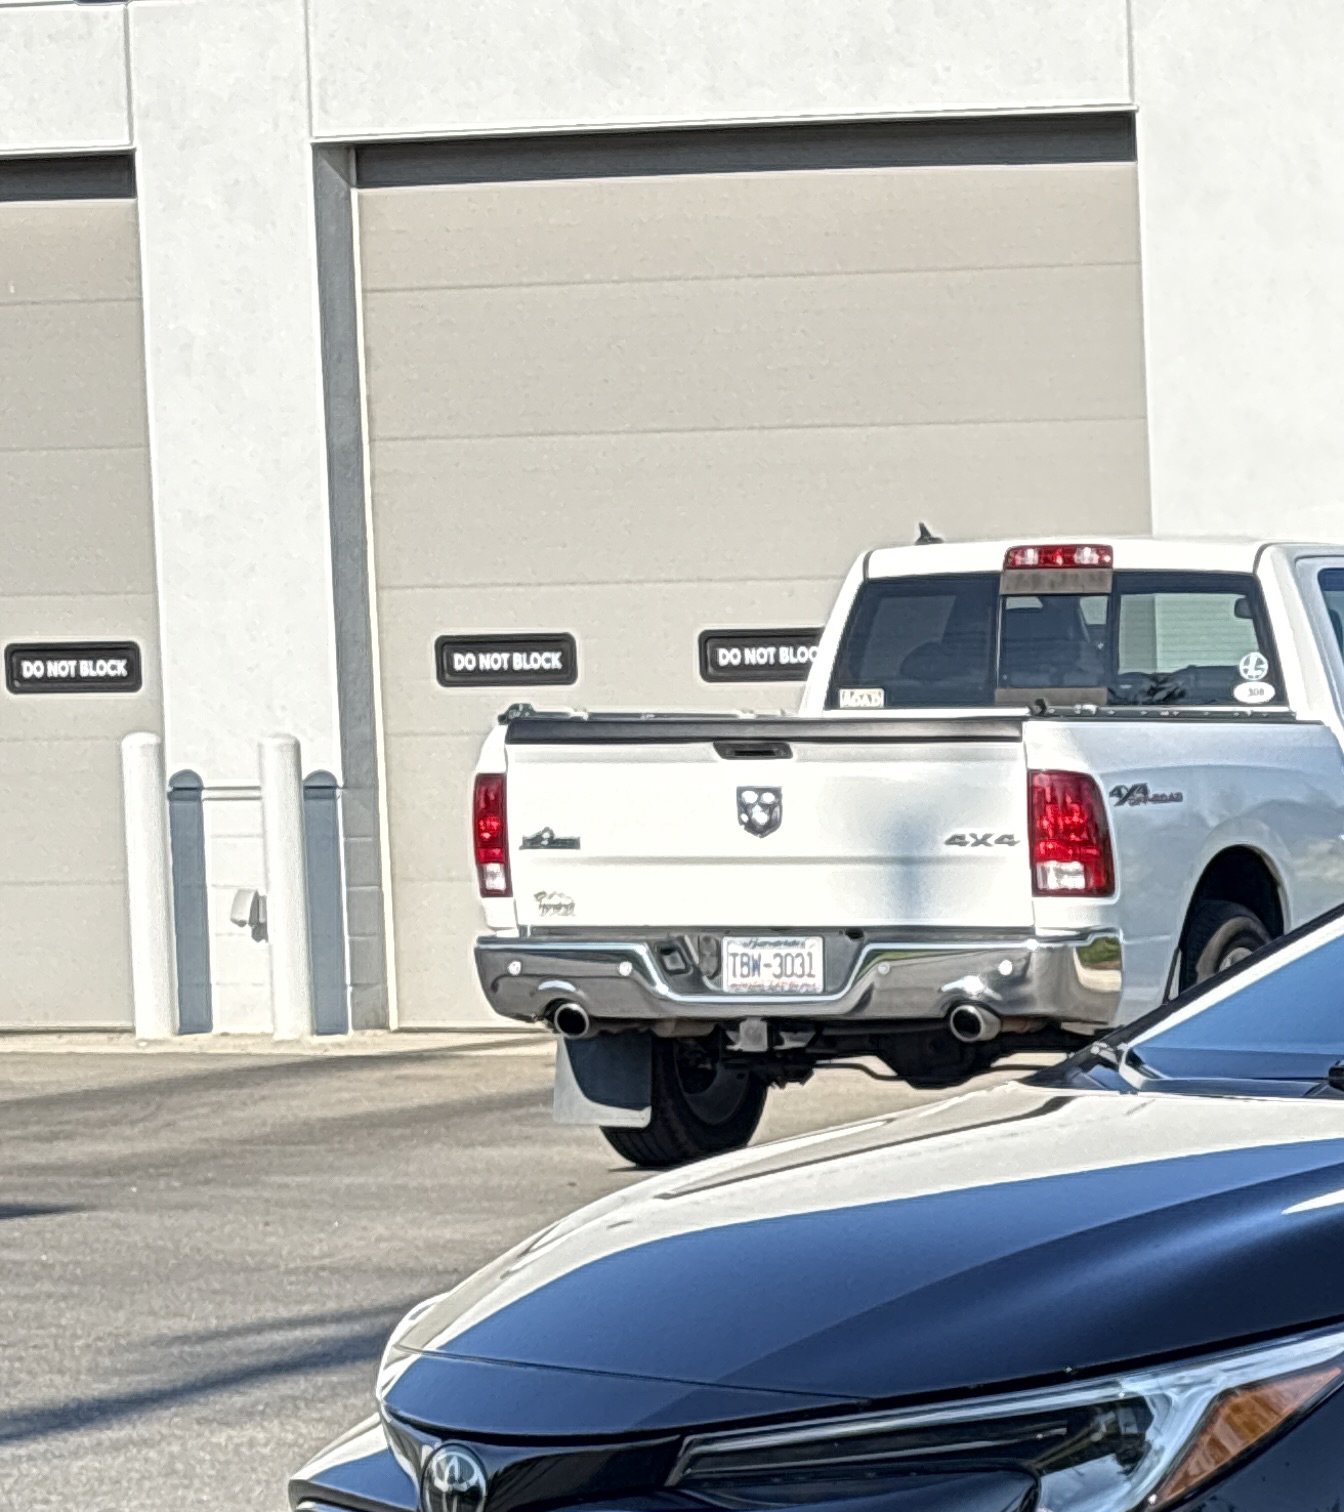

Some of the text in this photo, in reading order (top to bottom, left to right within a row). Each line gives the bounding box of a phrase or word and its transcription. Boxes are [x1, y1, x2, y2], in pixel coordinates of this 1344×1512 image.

[453, 651, 562, 671] DO NOT BLOCK
[718, 646, 819, 666] DO NOT BLOC
[21, 659, 128, 679] DO NOT BLOCK
